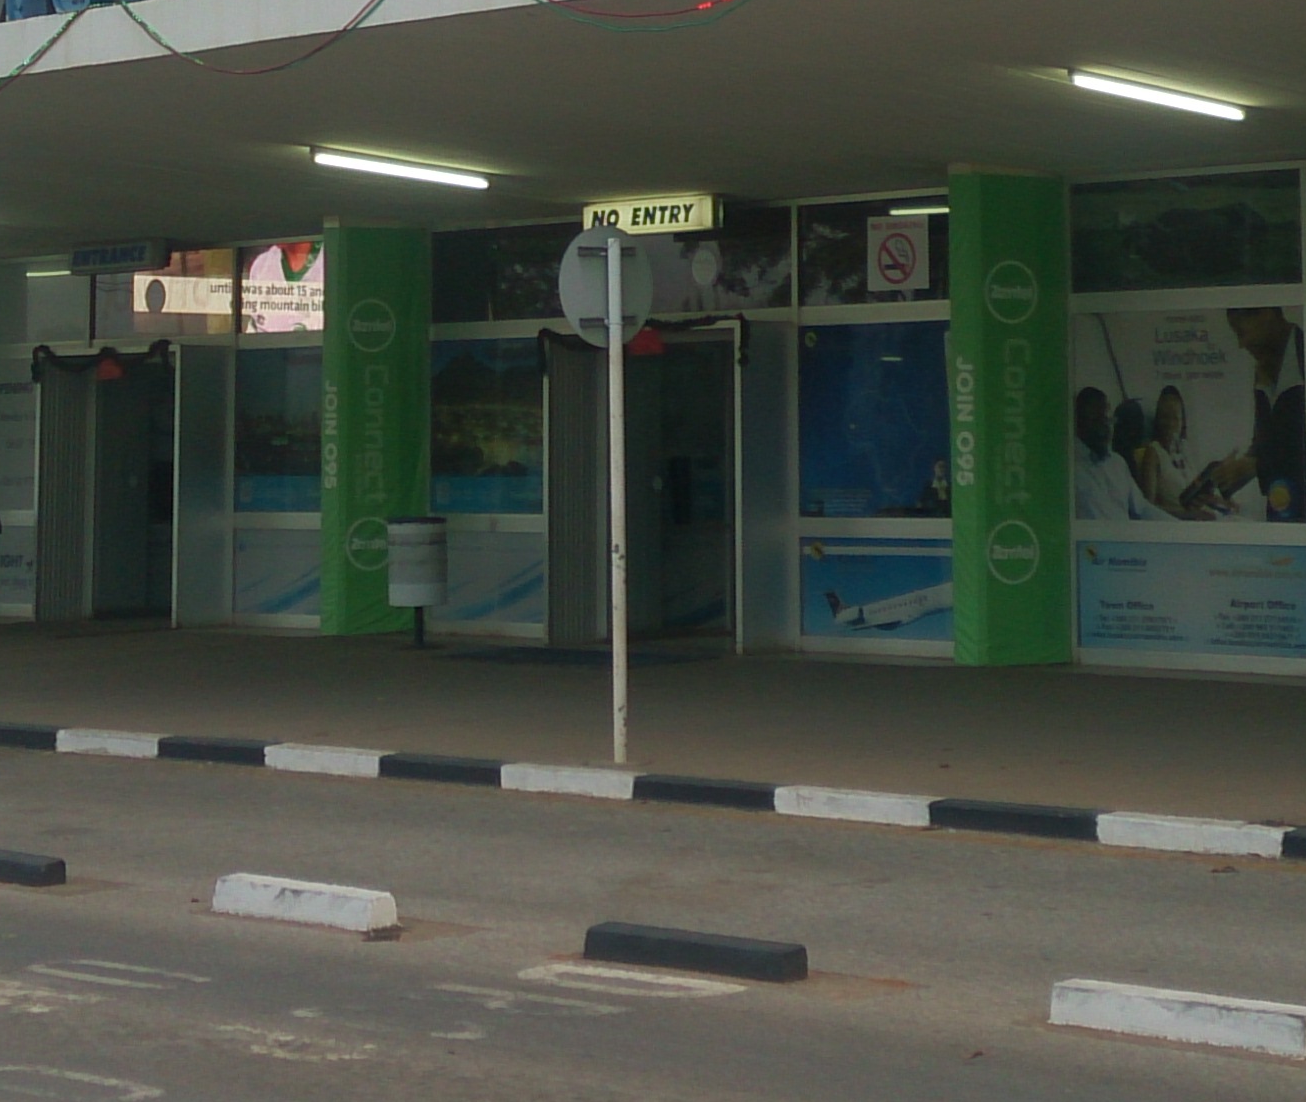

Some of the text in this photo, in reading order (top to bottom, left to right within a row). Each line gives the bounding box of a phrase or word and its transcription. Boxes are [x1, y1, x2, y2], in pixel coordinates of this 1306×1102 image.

[591, 203, 694, 227] NO ENTRY
[242, 286, 262, 296] was
[265, 282, 294, 296] about
[297, 285, 306, 297] 15
[309, 288, 322, 297] an
[260, 300, 309, 311] mountain
[312, 301, 322, 312] bi
[1154, 327, 1209, 344] Lusaka
[1152, 348, 1227, 366] Windhoek
[955, 356, 975, 423] JOIN
[324, 379, 338, 436] JOIN
[363, 364, 390, 504] Connect
[1003, 337, 1033, 507] Connect
